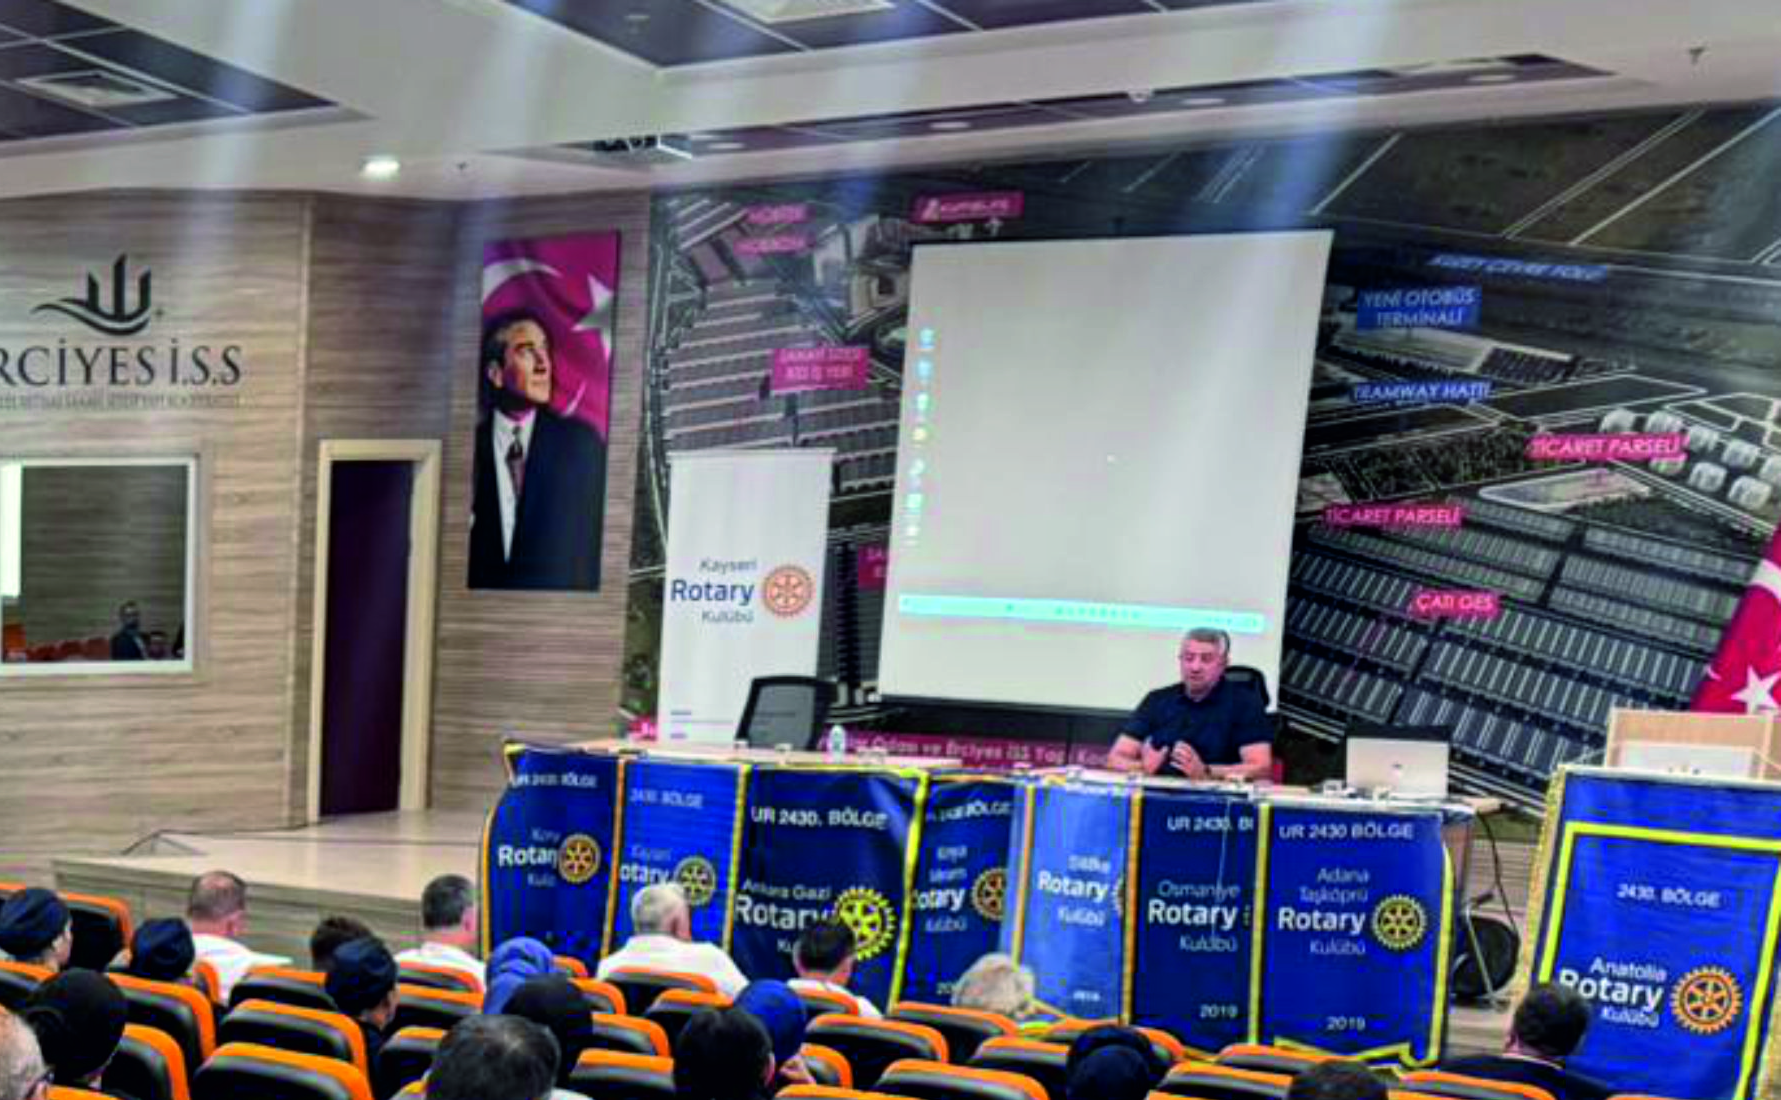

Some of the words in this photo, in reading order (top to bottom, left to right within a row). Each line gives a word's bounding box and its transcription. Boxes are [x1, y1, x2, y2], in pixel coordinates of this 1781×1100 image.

[1404, 285, 1478, 307] OTOBÜS
[1531, 437, 1603, 457] TİCARET
[1607, 436, 1682, 456] PARSELİ
[1327, 506, 1389, 524] TİCARET
[1394, 506, 1462, 525] PARSELİ
[699, 556, 758, 575] Kayseri
[670, 578, 756, 606] Rotary
[701, 609, 755, 625] Kulübü
[750, 805, 775, 825] UR
[779, 808, 823, 827] 2430.
[828, 805, 888, 830] BÖLGE
[1167, 814, 1190, 831] UR
[1278, 824, 1304, 840] UR
[1309, 823, 1347, 839] 2430
[1351, 819, 1415, 840] BÖLGE
[1317, 868, 1370, 883] Adana
[1038, 871, 1109, 902] Rotary
[1661, 886, 1720, 907] BÖLGE
[1149, 899, 1238, 931] Rotary
[1278, 907, 1366, 936] Rotary
[1310, 939, 1366, 955] Kulübü
[1590, 956, 1666, 981] Anatolia
